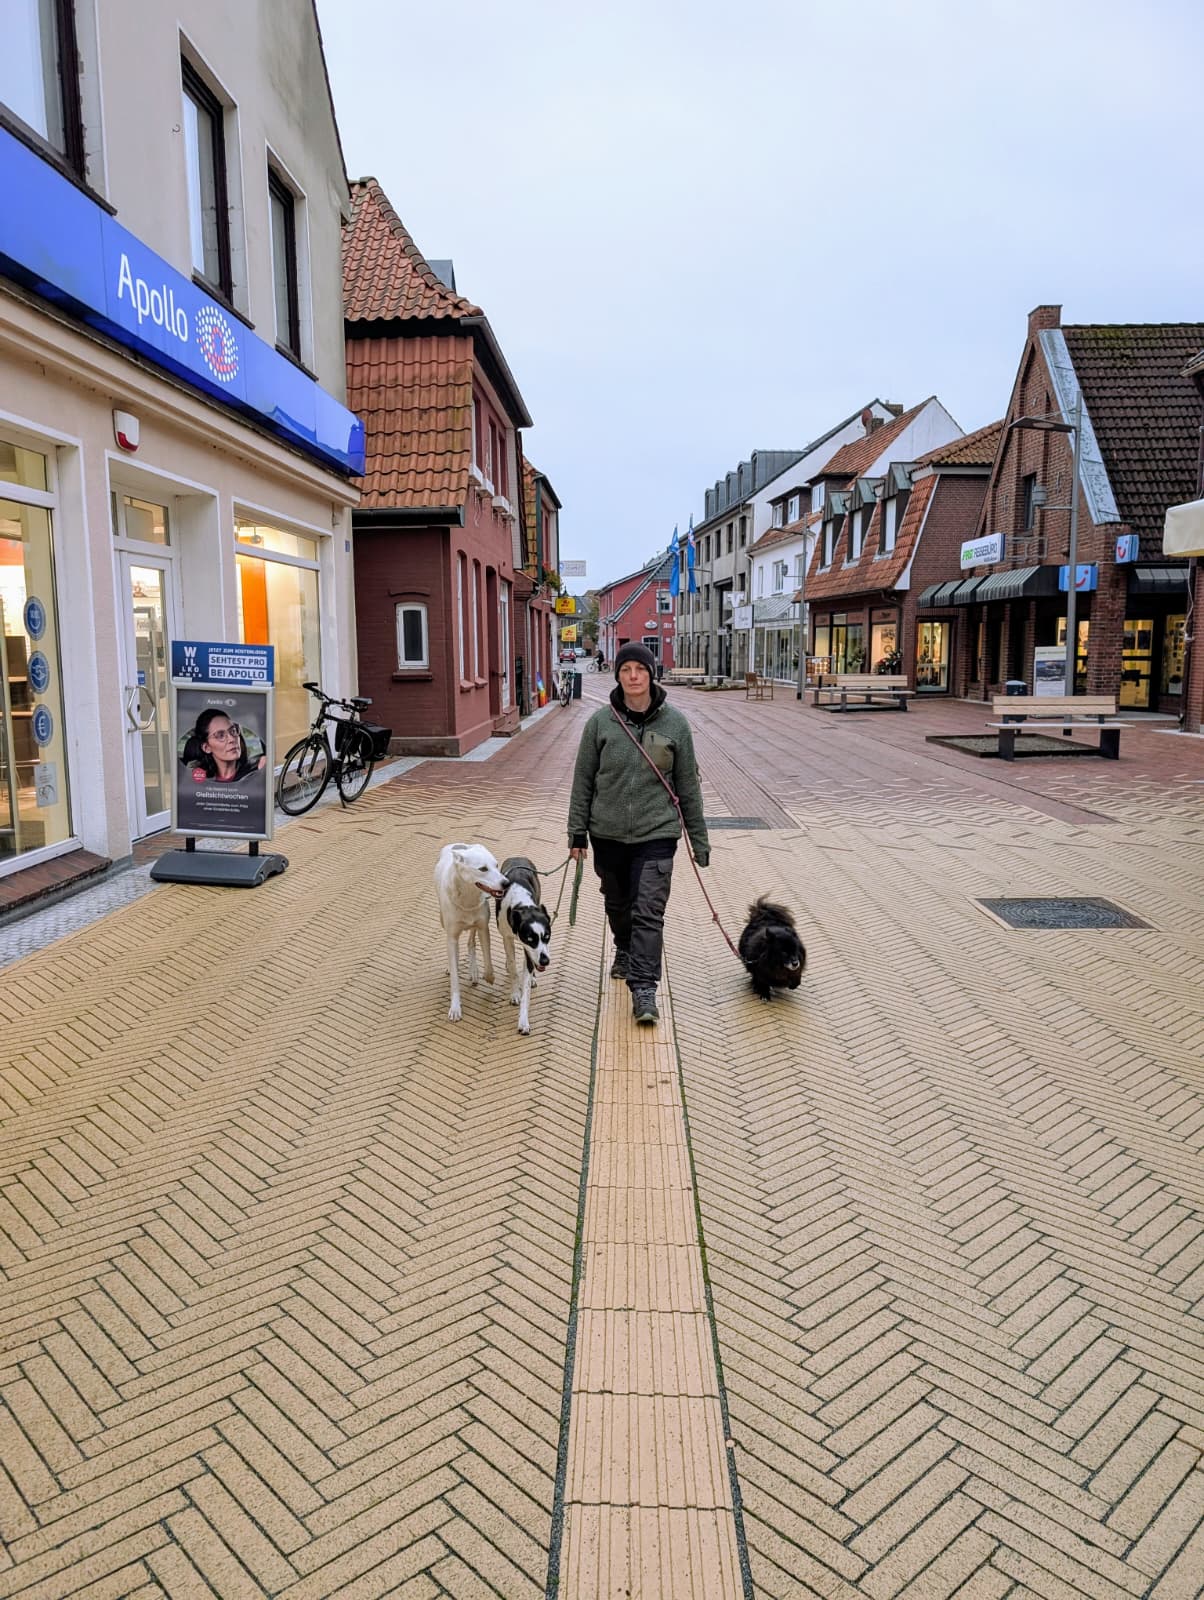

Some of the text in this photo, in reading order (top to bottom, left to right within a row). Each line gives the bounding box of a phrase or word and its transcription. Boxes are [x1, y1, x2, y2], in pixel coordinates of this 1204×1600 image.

[117, 252, 189, 343] Apollo
[183, 646, 197, 658] W
[210, 656, 265, 666] SEHTEST PRO
[210, 668, 226, 677] BEI
[227, 669, 265, 679] APOLLO
